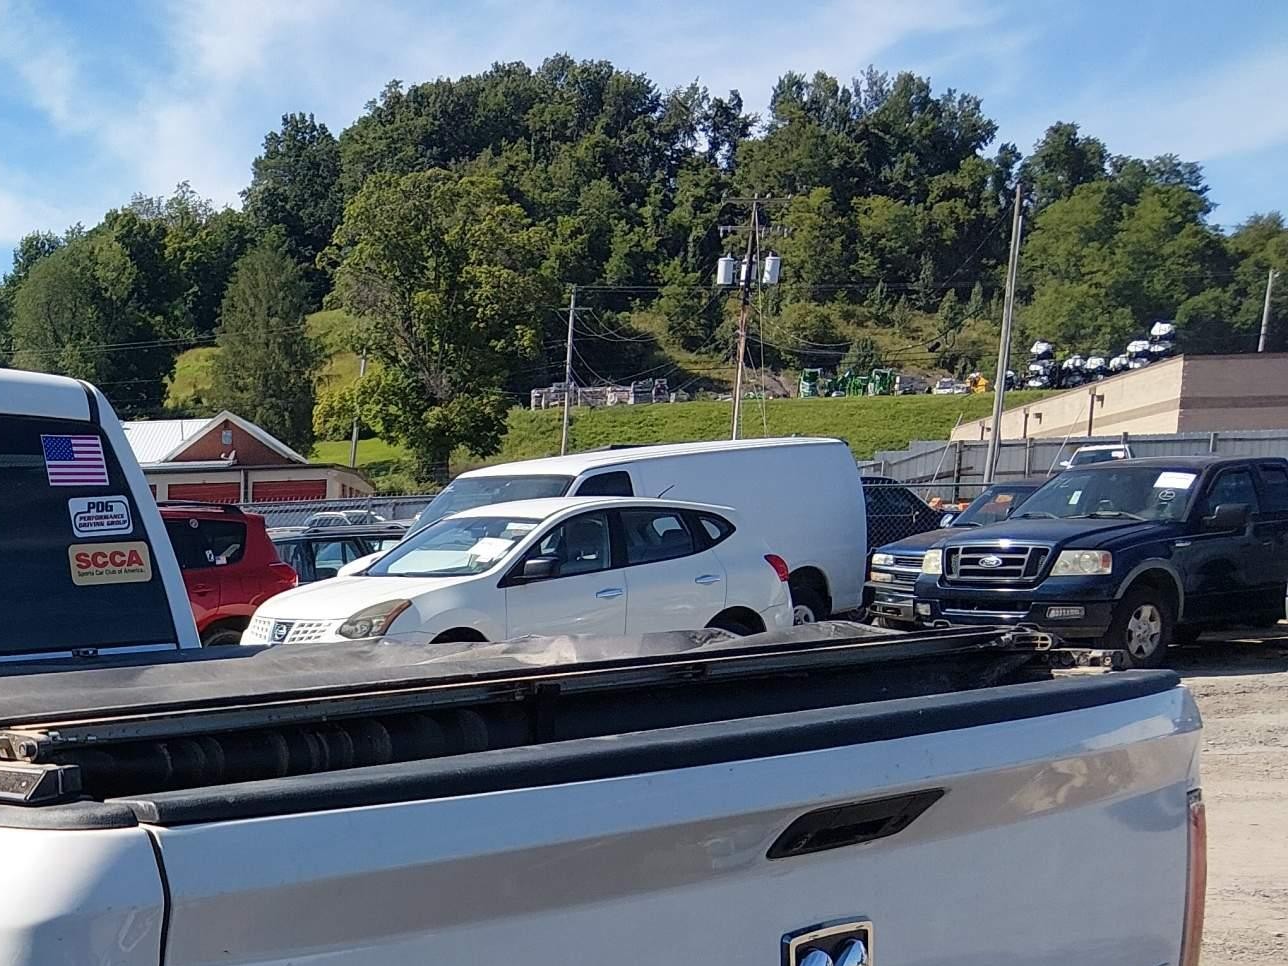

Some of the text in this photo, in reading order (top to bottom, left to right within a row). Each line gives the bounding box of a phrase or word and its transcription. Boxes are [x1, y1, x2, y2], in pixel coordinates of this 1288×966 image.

[87, 501, 114, 513] PDG
[79, 513, 125, 521] PERFORMANCE
[75, 549, 144, 569] SCCA
